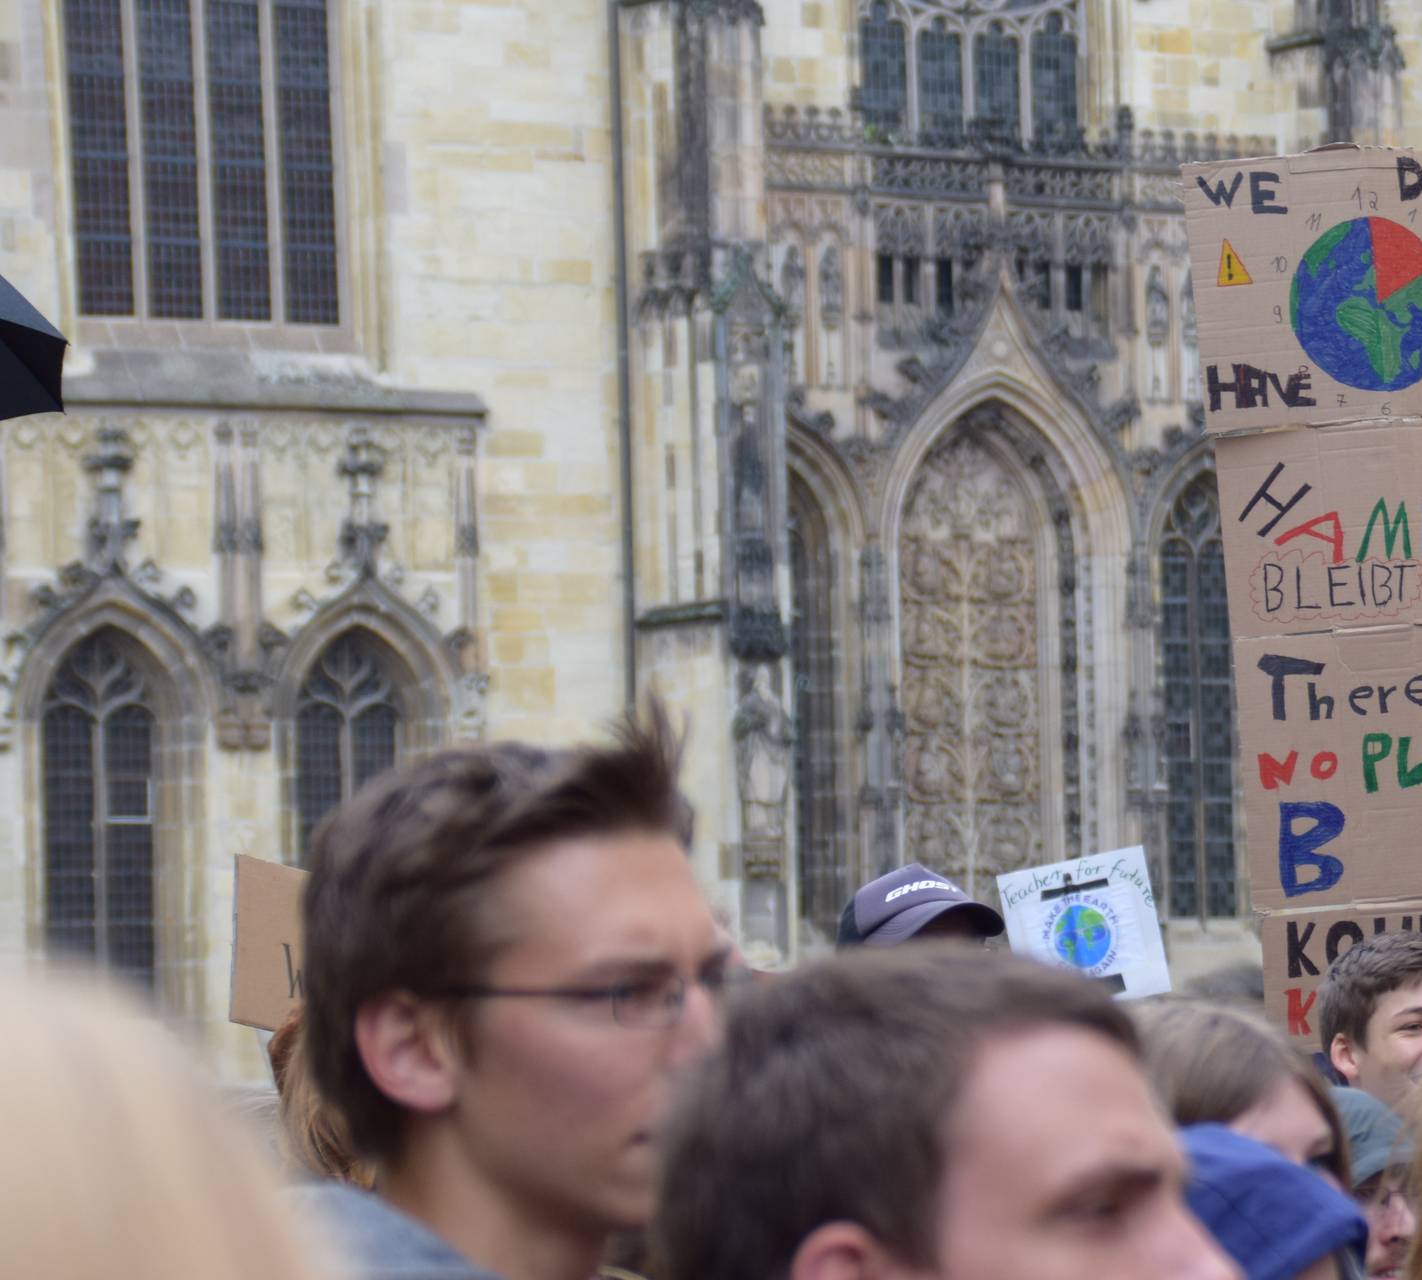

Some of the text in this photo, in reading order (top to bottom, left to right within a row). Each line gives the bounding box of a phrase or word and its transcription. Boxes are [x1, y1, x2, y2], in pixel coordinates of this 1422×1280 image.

[1196, 170, 1289, 215] WE
[1351, 186, 1379, 212] 12
[1271, 254, 1289, 273] 10
[1272, 304, 1282, 324] 9
[1205, 363, 1317, 412] HAVE
[1336, 393, 1347, 408] 7
[1380, 400, 1393, 416] 6
[1257, 750, 1339, 790] NO
[1278, 800, 1346, 898] B
[1082, 894, 1120, 926] EARTH
